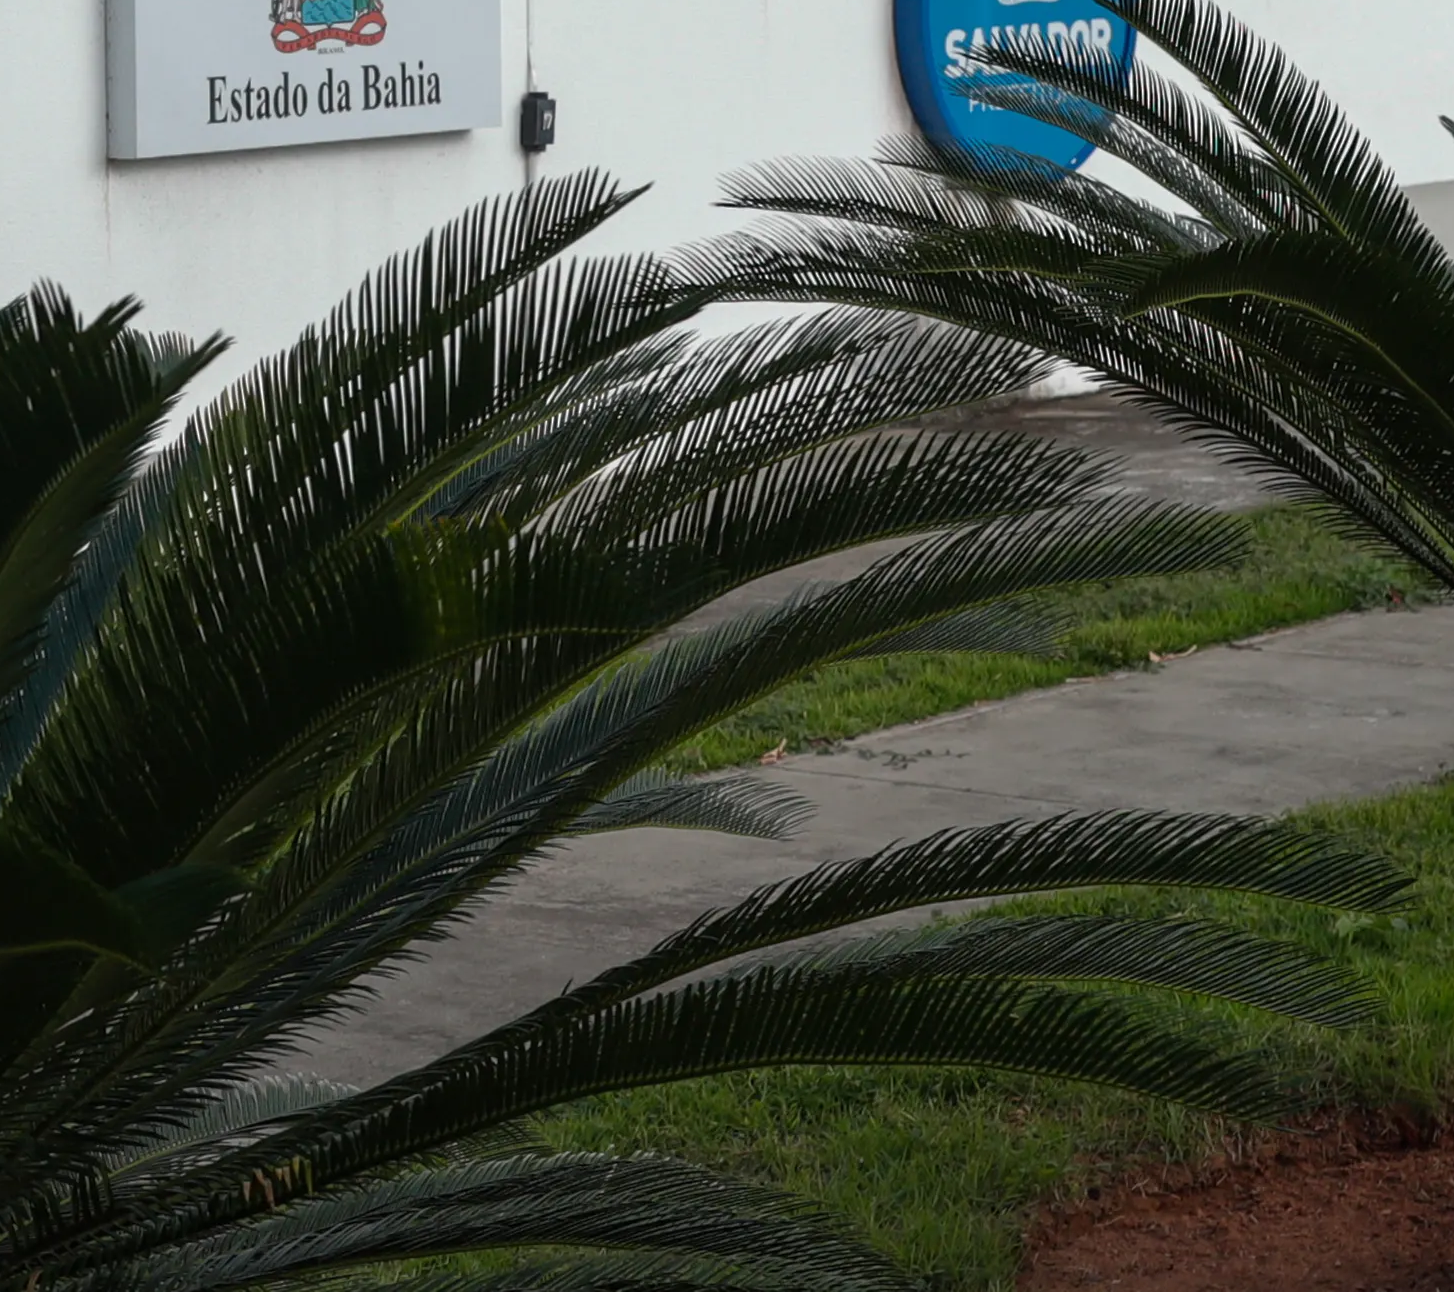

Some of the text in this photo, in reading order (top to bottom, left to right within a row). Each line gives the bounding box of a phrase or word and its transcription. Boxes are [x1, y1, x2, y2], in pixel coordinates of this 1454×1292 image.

[206, 60, 442, 125] Estado da Bahia
